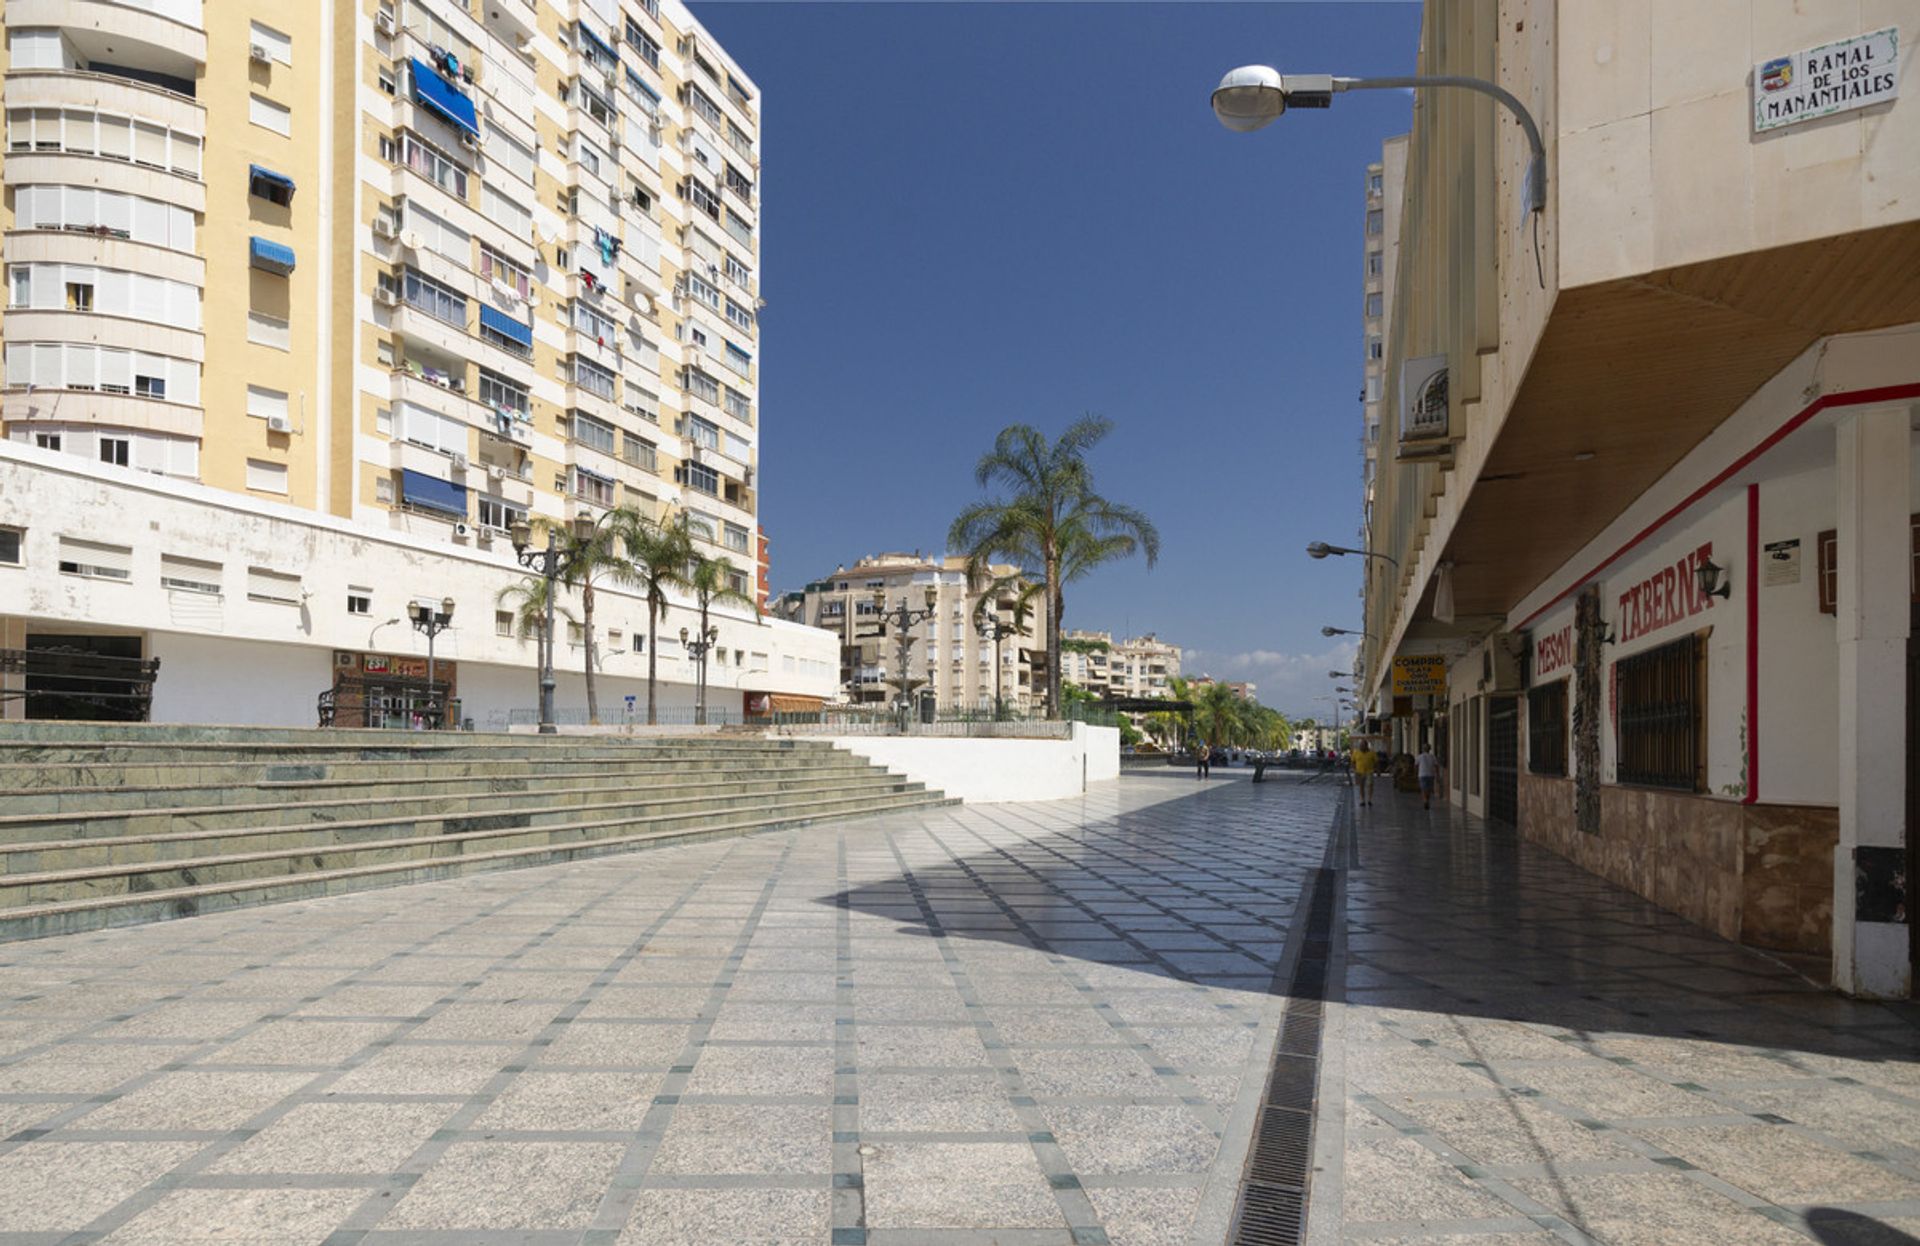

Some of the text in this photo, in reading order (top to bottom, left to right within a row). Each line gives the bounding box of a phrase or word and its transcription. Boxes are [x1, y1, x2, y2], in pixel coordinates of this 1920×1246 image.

[1808, 45, 1874, 75] RAMAL
[1813, 65, 1870, 90] DE LOS
[1767, 74, 1894, 119] MANANTIALES
[1395, 657, 1444, 667] COMPRO
